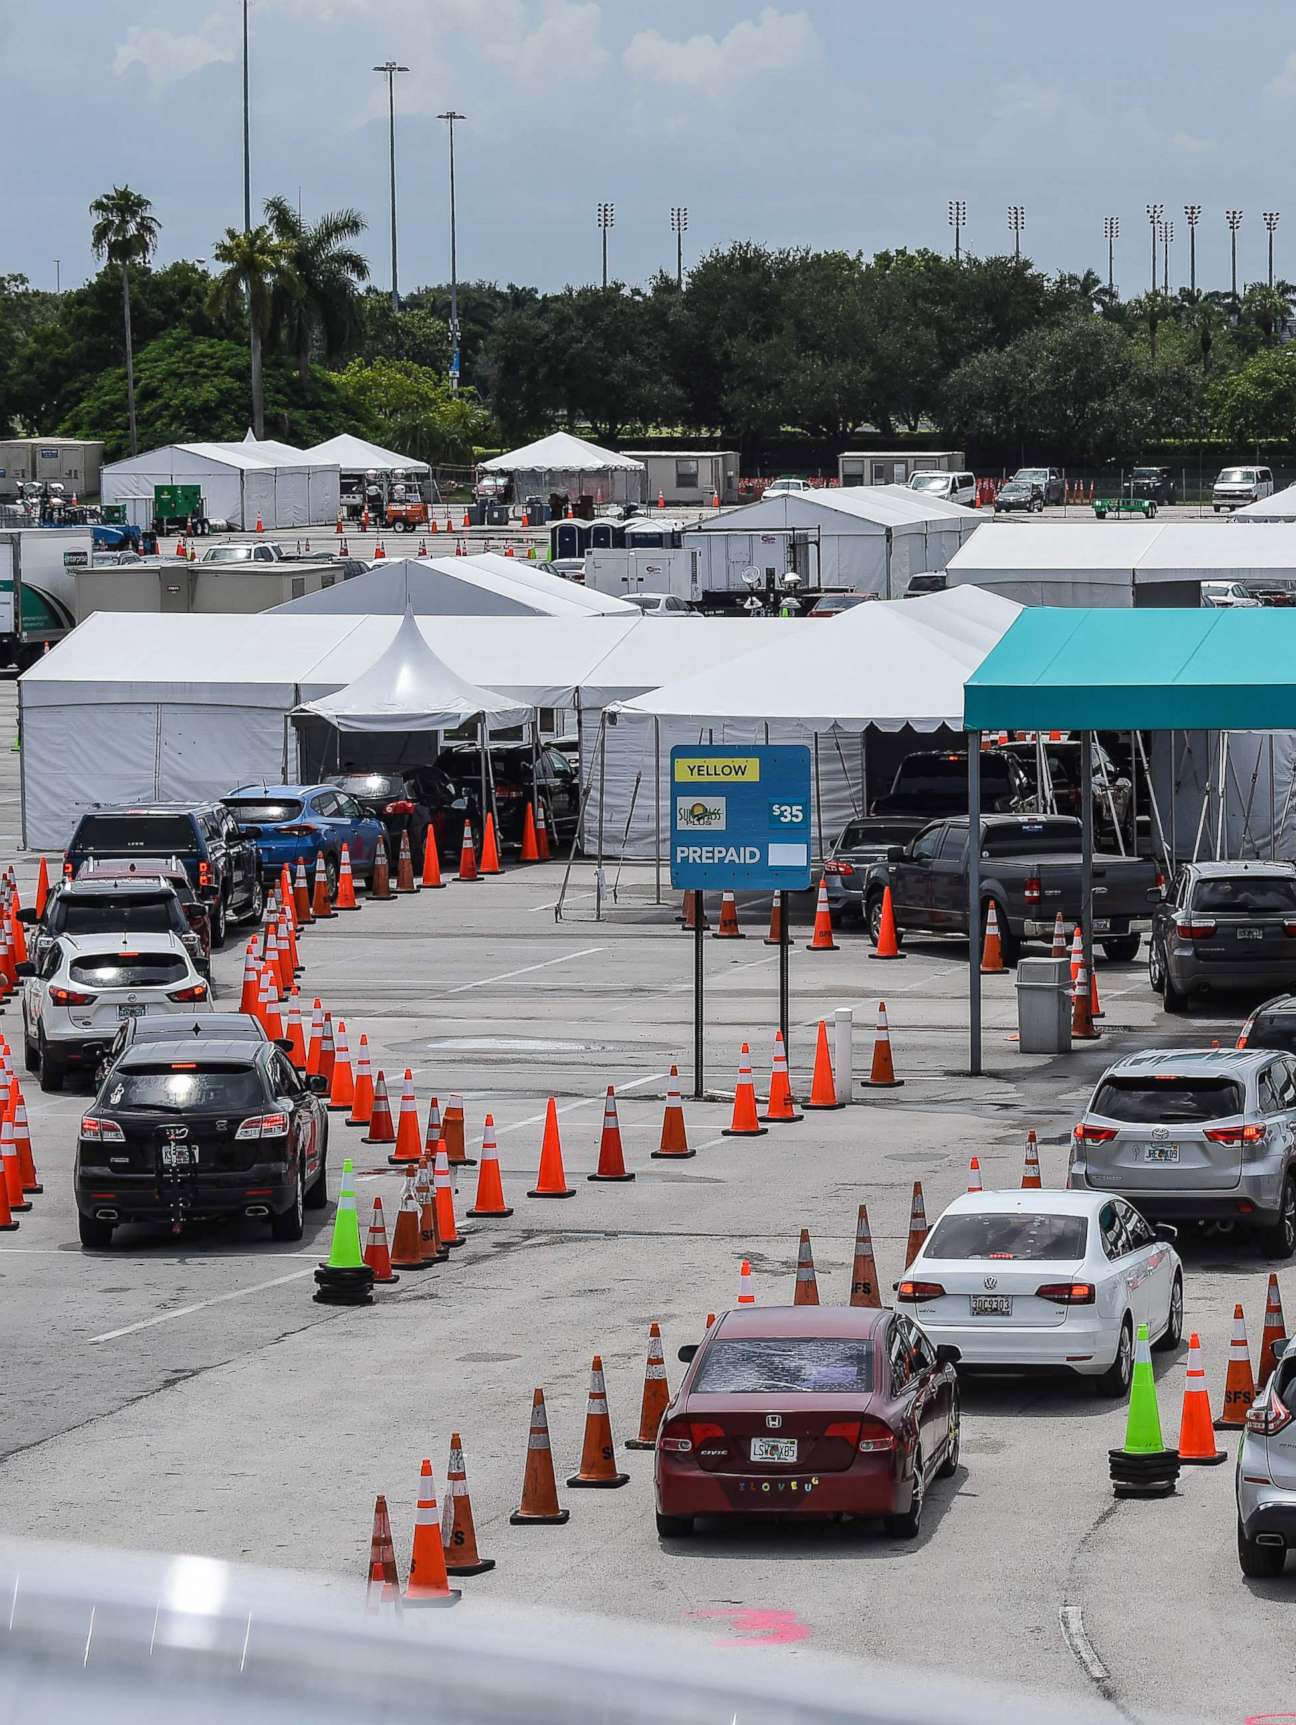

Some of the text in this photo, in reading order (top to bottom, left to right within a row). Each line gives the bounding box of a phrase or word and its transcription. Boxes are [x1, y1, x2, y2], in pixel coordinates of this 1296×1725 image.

[687, 764, 748, 777] YELLOW
[772, 804, 804, 823] $35
[676, 846, 761, 864] PREPAID
[1225, 1390, 1251, 1405] SFS
